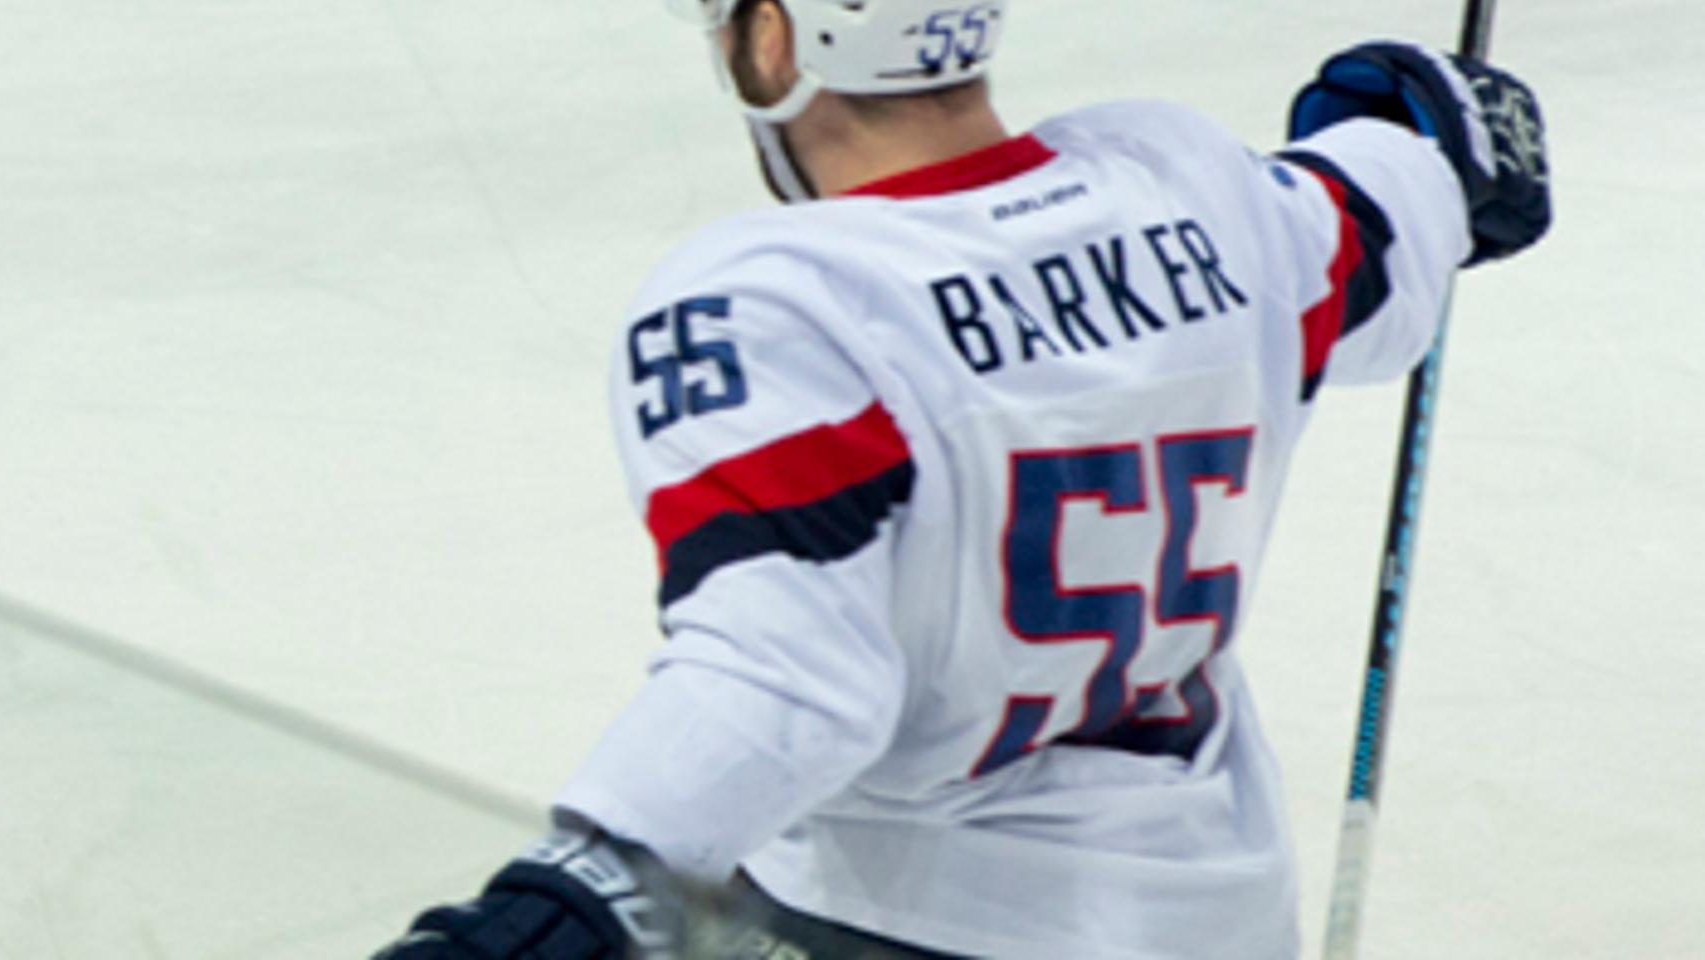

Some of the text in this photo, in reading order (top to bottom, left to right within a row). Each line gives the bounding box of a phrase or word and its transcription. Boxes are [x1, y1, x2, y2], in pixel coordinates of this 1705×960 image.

[916, 3, 996, 75] 55
[627, 296, 748, 440] 55
[930, 218, 1249, 376] BARKER
[970, 426, 1256, 779] 55
